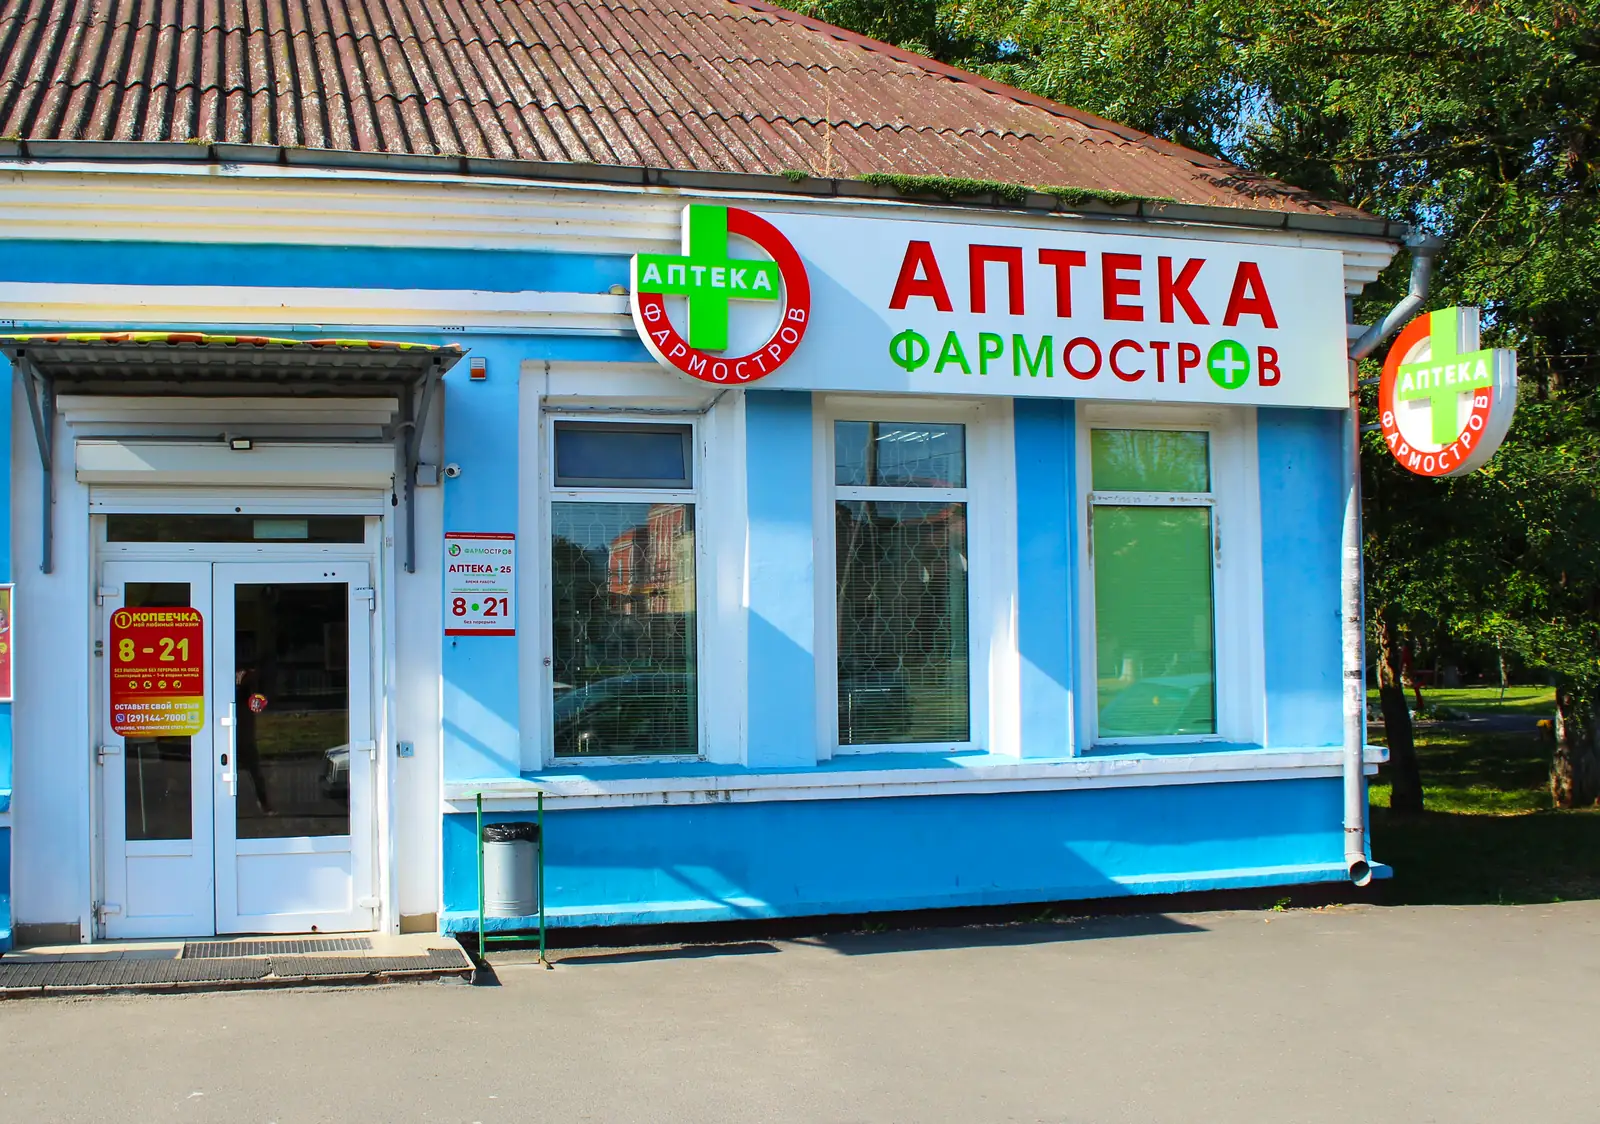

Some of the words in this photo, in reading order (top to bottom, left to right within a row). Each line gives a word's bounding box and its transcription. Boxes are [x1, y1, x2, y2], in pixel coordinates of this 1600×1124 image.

[642, 263, 772, 291] АПТЕКА
[888, 240, 1279, 329] АПТЕКА
[644, 303, 806, 381] ФАРМОСТРОВ
[1400, 359, 1488, 393] АПТЕКА
[1382, 395, 1488, 473] ФАРМОСТРОВ
[448, 564, 493, 573] АПТЕКА
[500, 565, 512, 573] 25
[132, 612, 199, 622] КОПЕЕЧКА
[452, 597, 467, 616] 8
[483, 597, 508, 616] 21
[119, 638, 135, 662] 8
[159, 637, 189, 661] 21
[126, 713, 187, 723] (29)144-7000
[150, 701, 172, 710] СВОЙ
